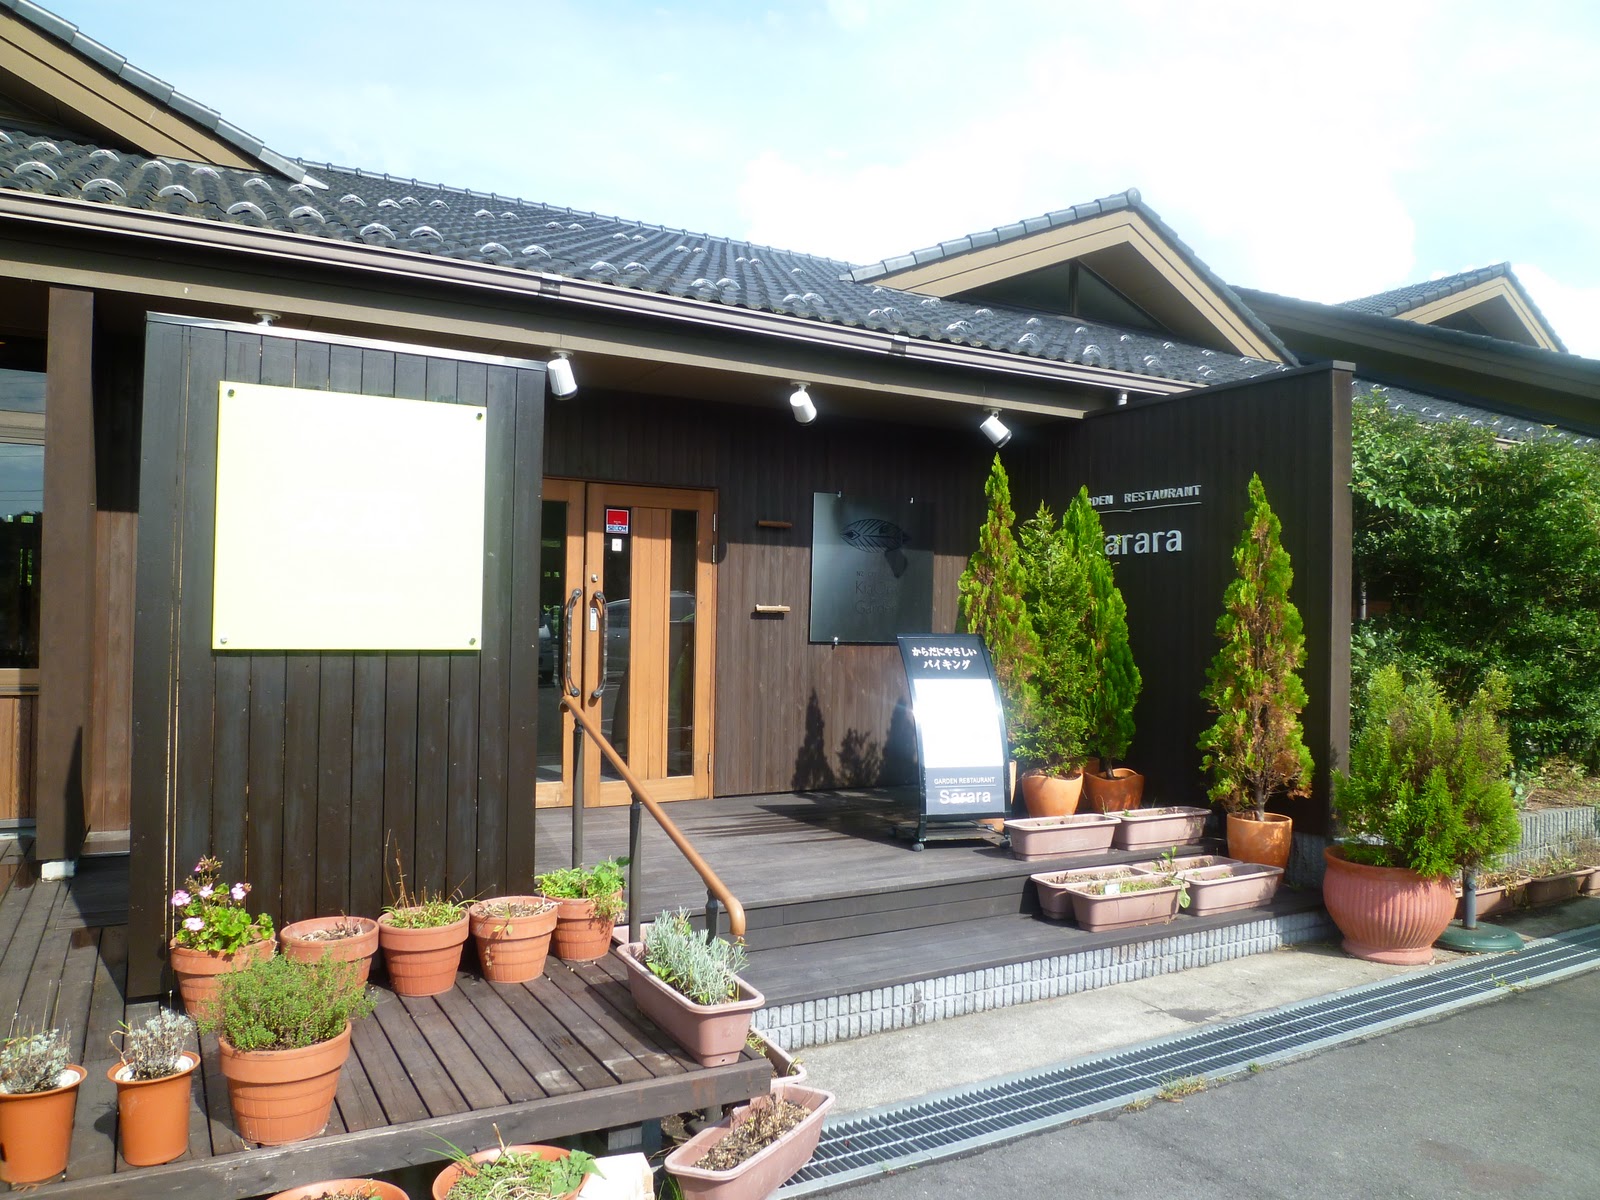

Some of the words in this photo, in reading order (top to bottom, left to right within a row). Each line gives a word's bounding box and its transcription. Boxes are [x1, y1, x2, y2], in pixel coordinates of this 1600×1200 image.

[1124, 485, 1201, 502] RESTAURANT
[1104, 529, 1182, 555] arara
[911, 646, 978, 657] からだにやさしい
[923, 659, 971, 671] バイキング
[940, 790, 991, 804] Sarara
